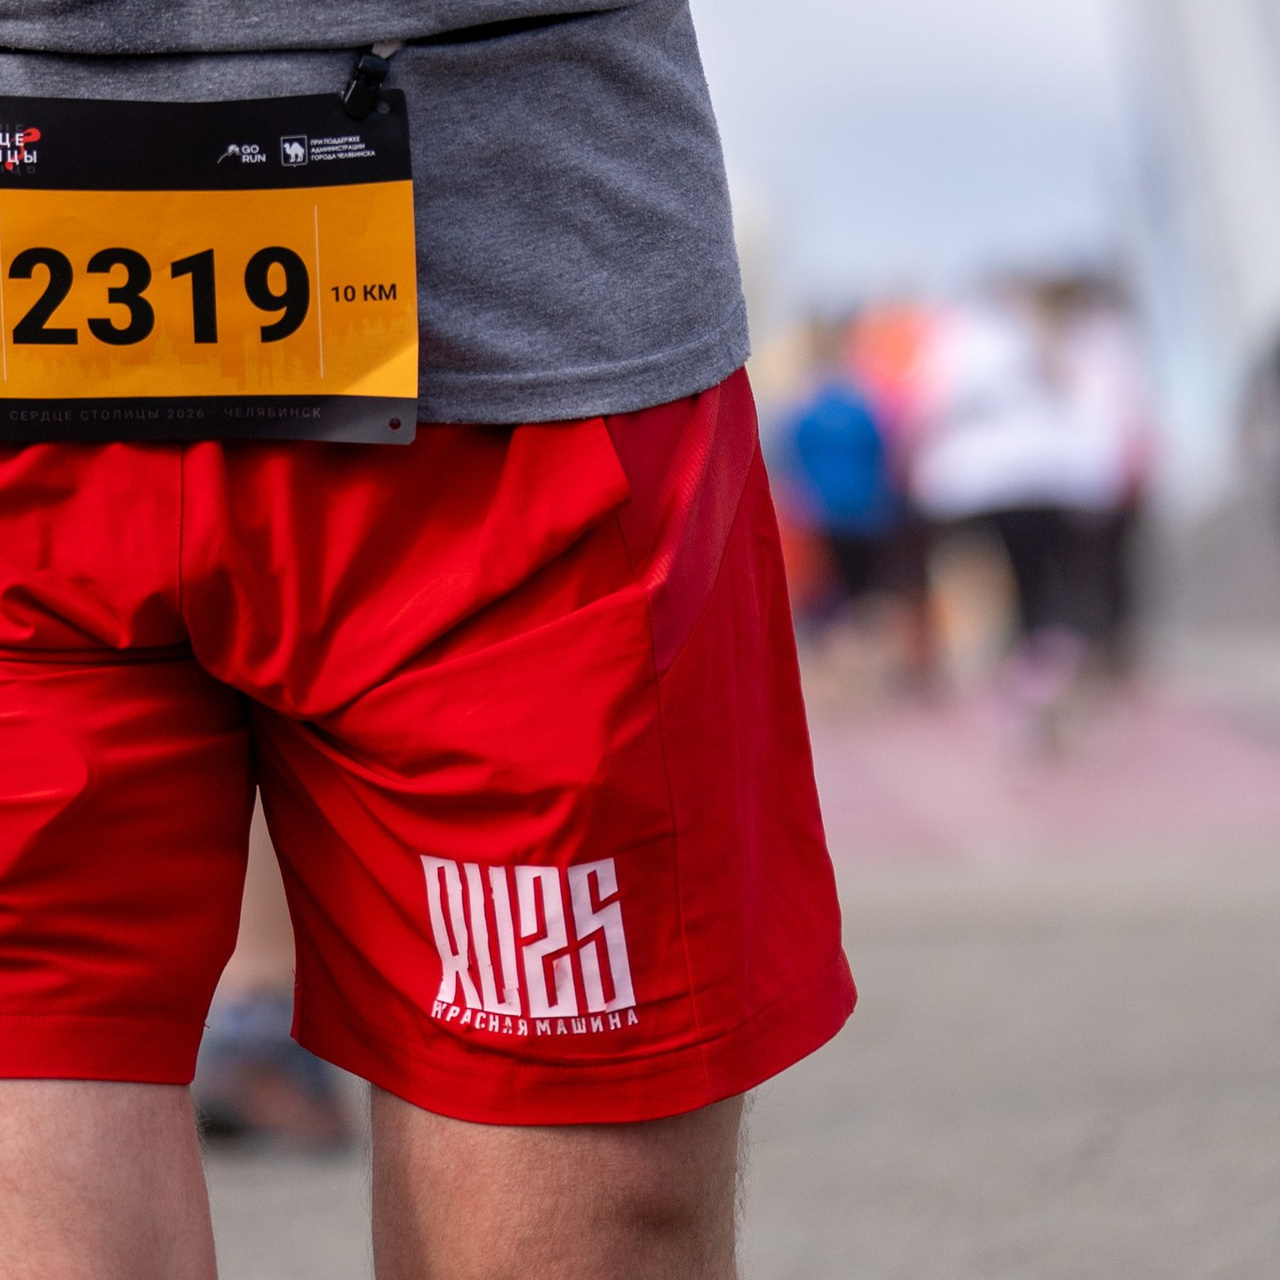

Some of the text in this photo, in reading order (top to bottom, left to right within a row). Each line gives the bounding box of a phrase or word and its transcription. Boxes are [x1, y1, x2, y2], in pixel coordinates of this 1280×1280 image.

[241, 144, 260, 154] GO
[242, 153, 267, 164] RUN
[7, 246, 311, 346] 2319
[331, 285, 356, 302] 10
[9, 406, 322, 423] СЕРДЦЕ СТОЛИЦЫ 2026 ЧЕЛЯБИНСК
[535, 1009, 639, 1037] МАШИНА
